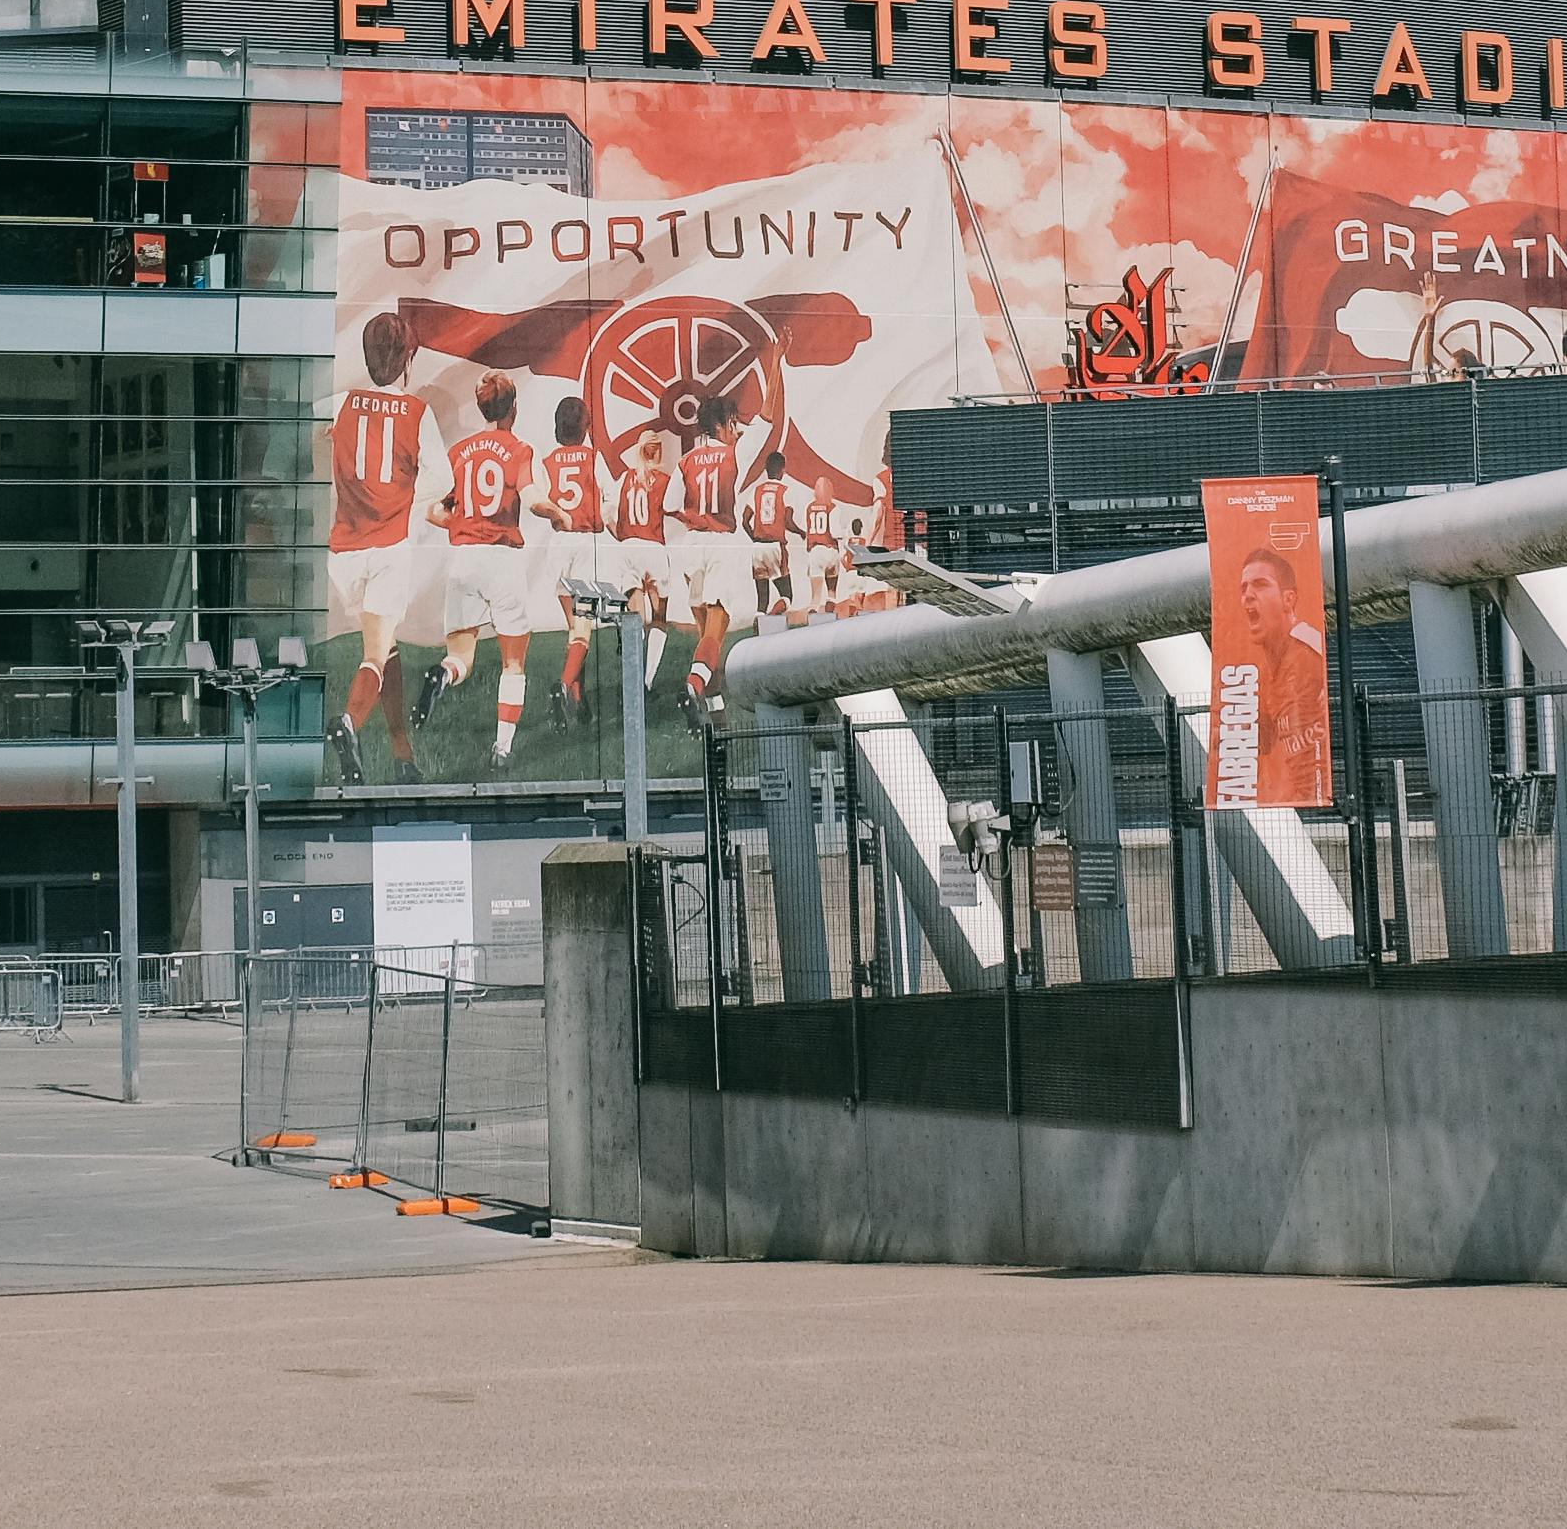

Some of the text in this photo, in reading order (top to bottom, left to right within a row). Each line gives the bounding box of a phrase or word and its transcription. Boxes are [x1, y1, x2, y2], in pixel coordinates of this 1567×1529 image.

[383, 207, 913, 270] OPPORTUNITY
[351, 395, 409, 415] GEORGE
[355, 415, 394, 483] 11
[460, 440, 512, 462] WILSHERE
[463, 459, 506, 519] 19
[557, 466, 584, 511] 5
[626, 487, 649, 526] 10
[695, 466, 719, 517] 11
[760, 492, 776, 524] 8
[1227, 496, 1257, 505] DANNY
[809, 511, 828, 534] 10
[1269, 522, 1311, 551] 4
[1216, 664, 1259, 810] FABREGAS
